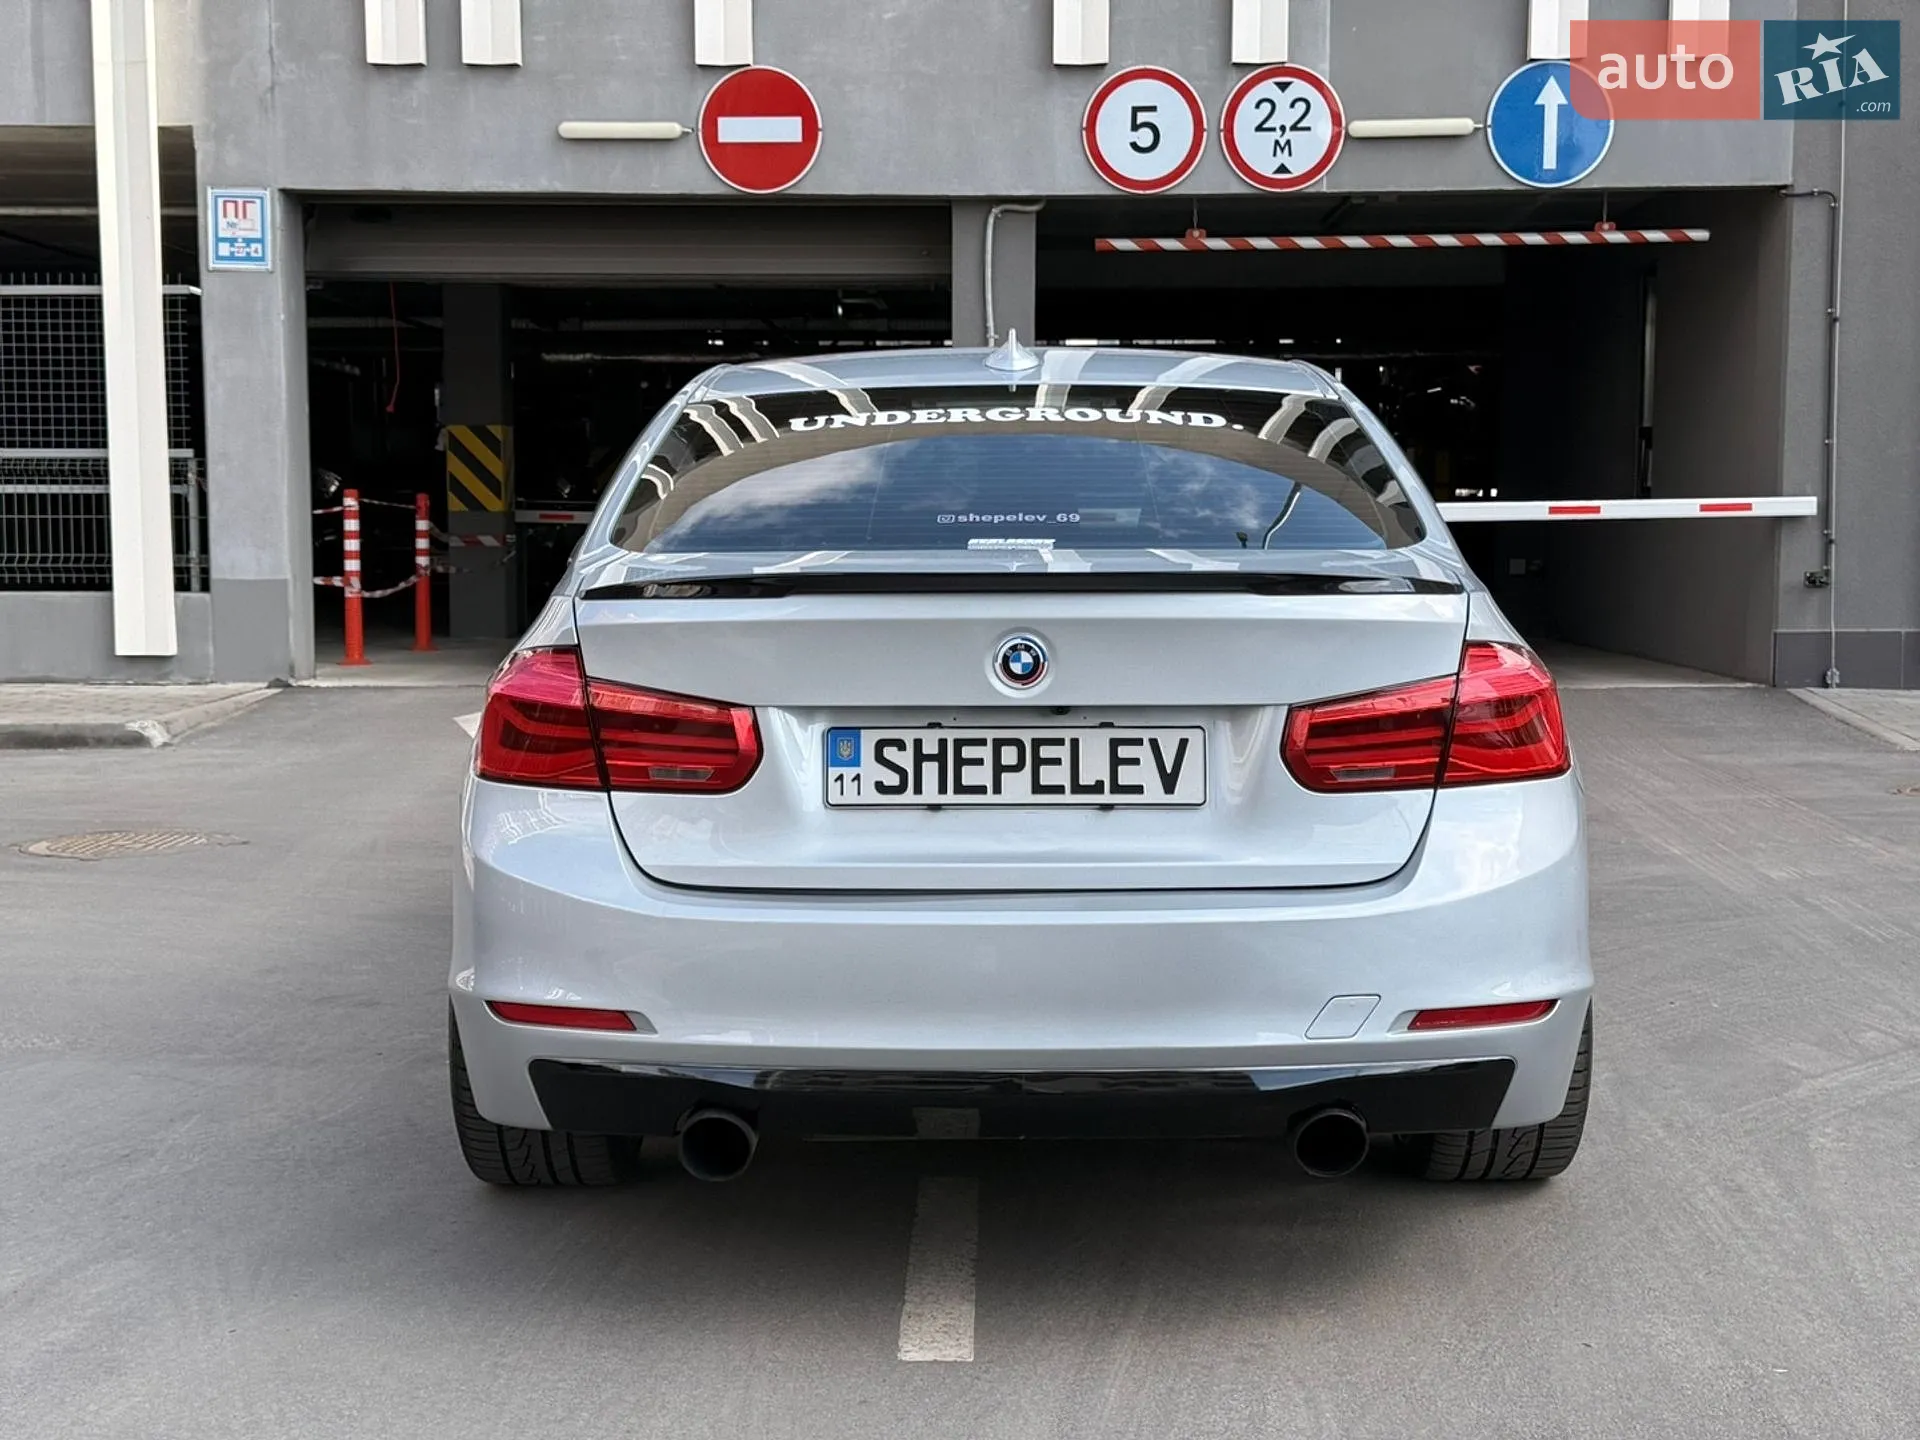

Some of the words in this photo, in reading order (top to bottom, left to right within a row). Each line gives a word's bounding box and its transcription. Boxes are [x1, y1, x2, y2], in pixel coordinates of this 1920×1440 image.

[1129, 105, 1161, 154] 5
[1254, 97, 1312, 138] 2,2
[834, 773, 861, 796] 11
[874, 738, 1190, 796] SHEPELEV
